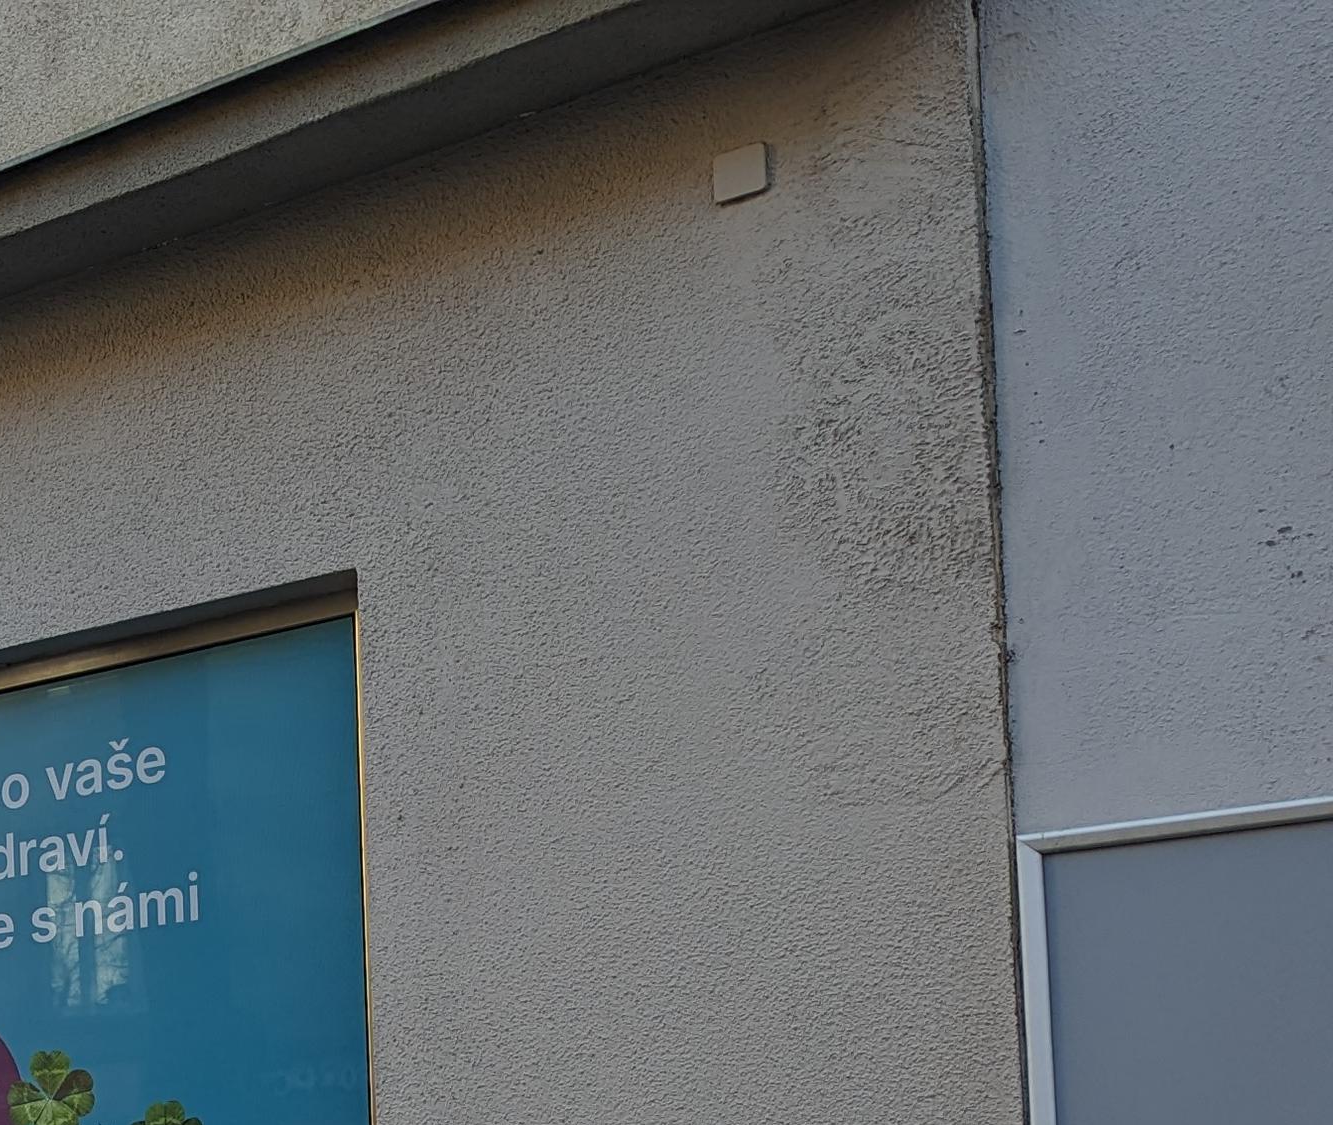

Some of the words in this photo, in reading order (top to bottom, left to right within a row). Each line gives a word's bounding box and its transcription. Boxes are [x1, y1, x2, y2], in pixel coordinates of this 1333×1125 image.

[2, 772, 29, 810] o
[46, 738, 167, 802] vaše
[31, 904, 57, 943] s
[75, 871, 201, 938] námi
